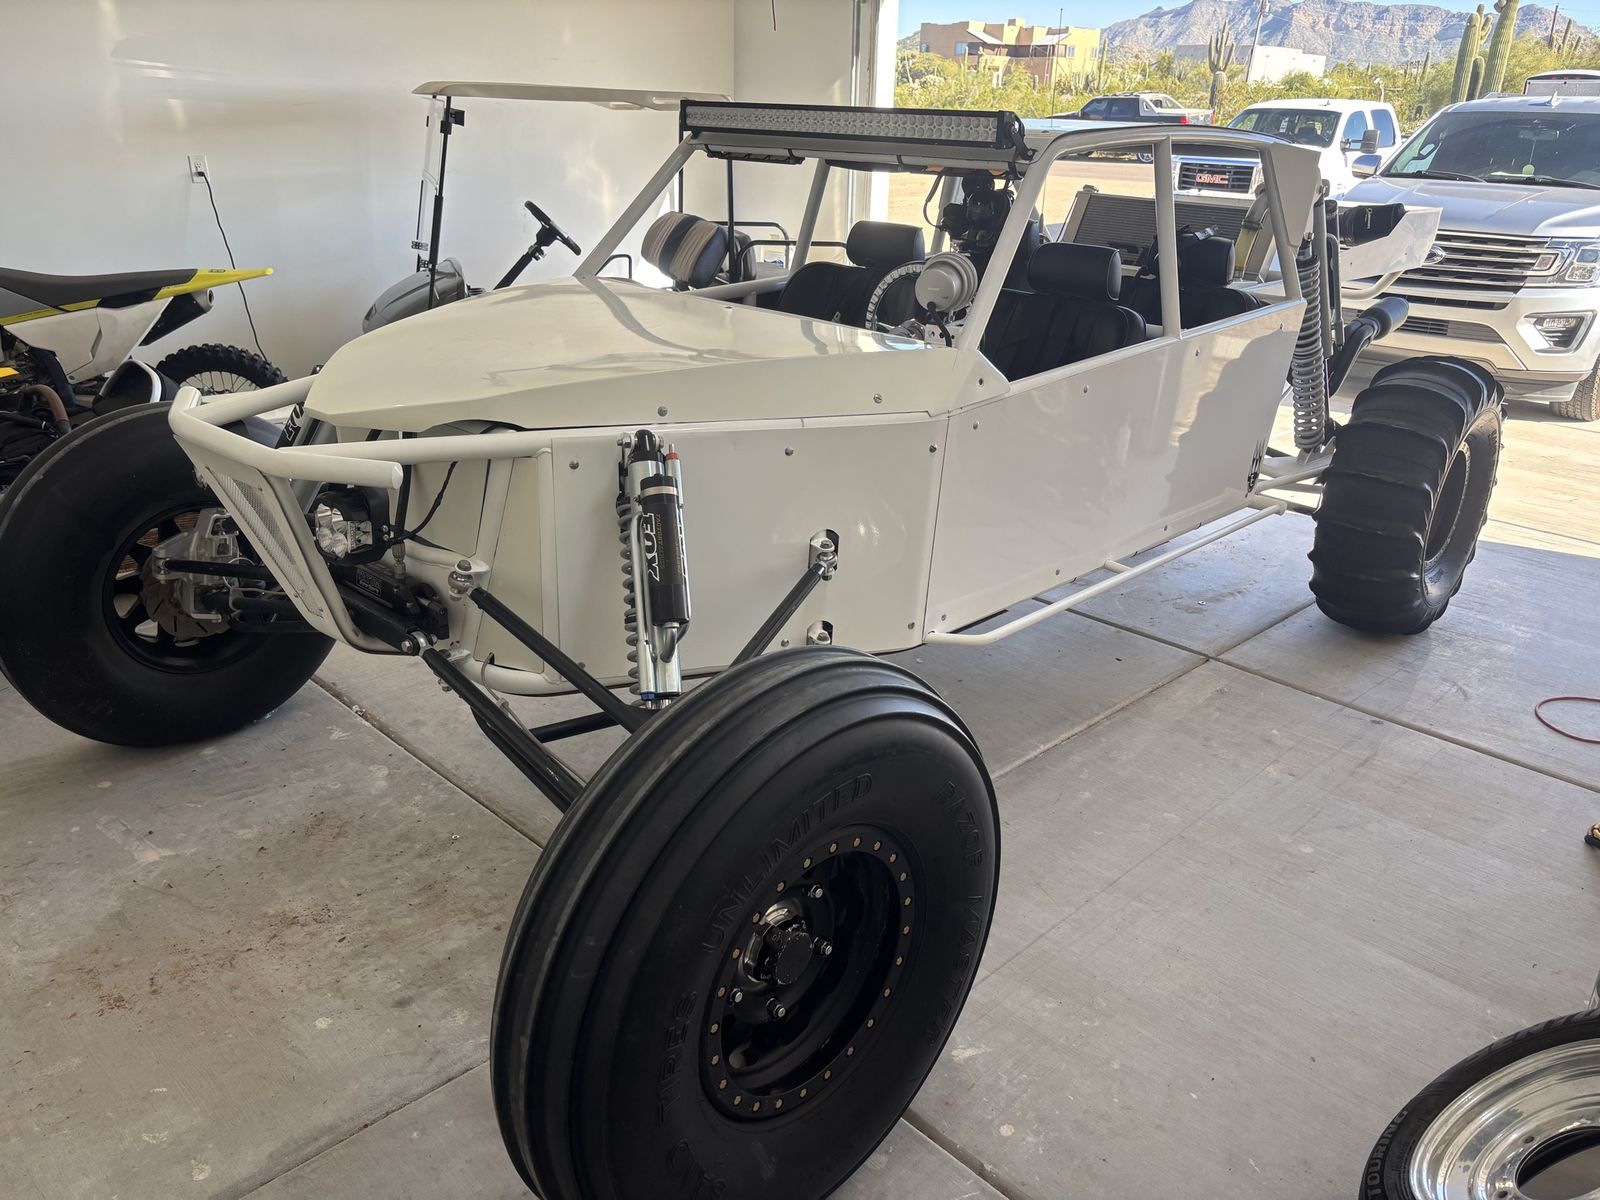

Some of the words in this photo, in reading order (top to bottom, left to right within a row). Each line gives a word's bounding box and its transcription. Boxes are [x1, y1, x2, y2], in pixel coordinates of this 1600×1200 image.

[1196, 174, 1229, 184] GMC
[643, 512, 660, 581] FOX
[701, 772, 873, 953] UNLIMITED
[656, 991, 697, 1127] TIRES
[1366, 1110, 1408, 1198] TOURING
